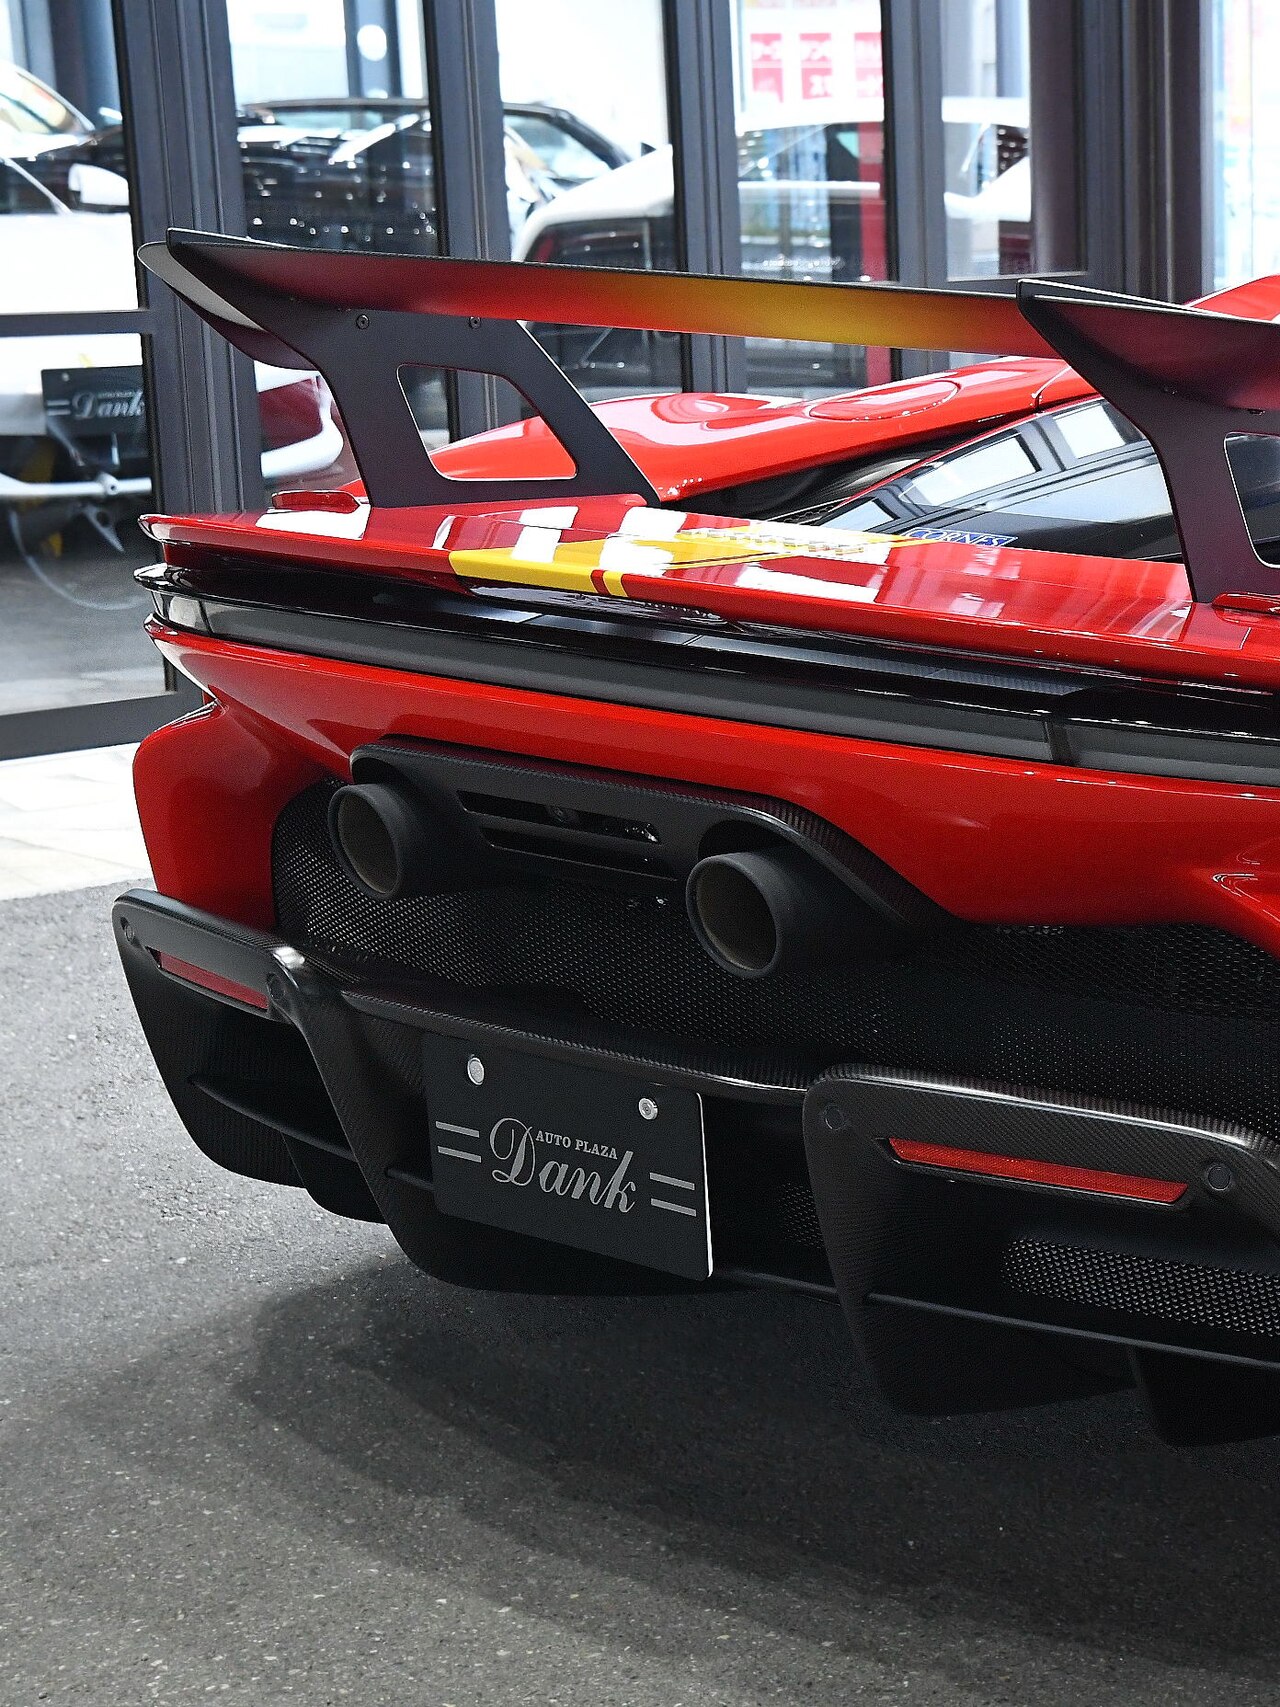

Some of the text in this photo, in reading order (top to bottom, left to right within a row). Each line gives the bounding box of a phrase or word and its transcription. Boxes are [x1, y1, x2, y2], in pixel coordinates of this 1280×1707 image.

[489, 1117, 636, 1213] Dank
[535, 1130, 618, 1160] AUTO PLAZA
